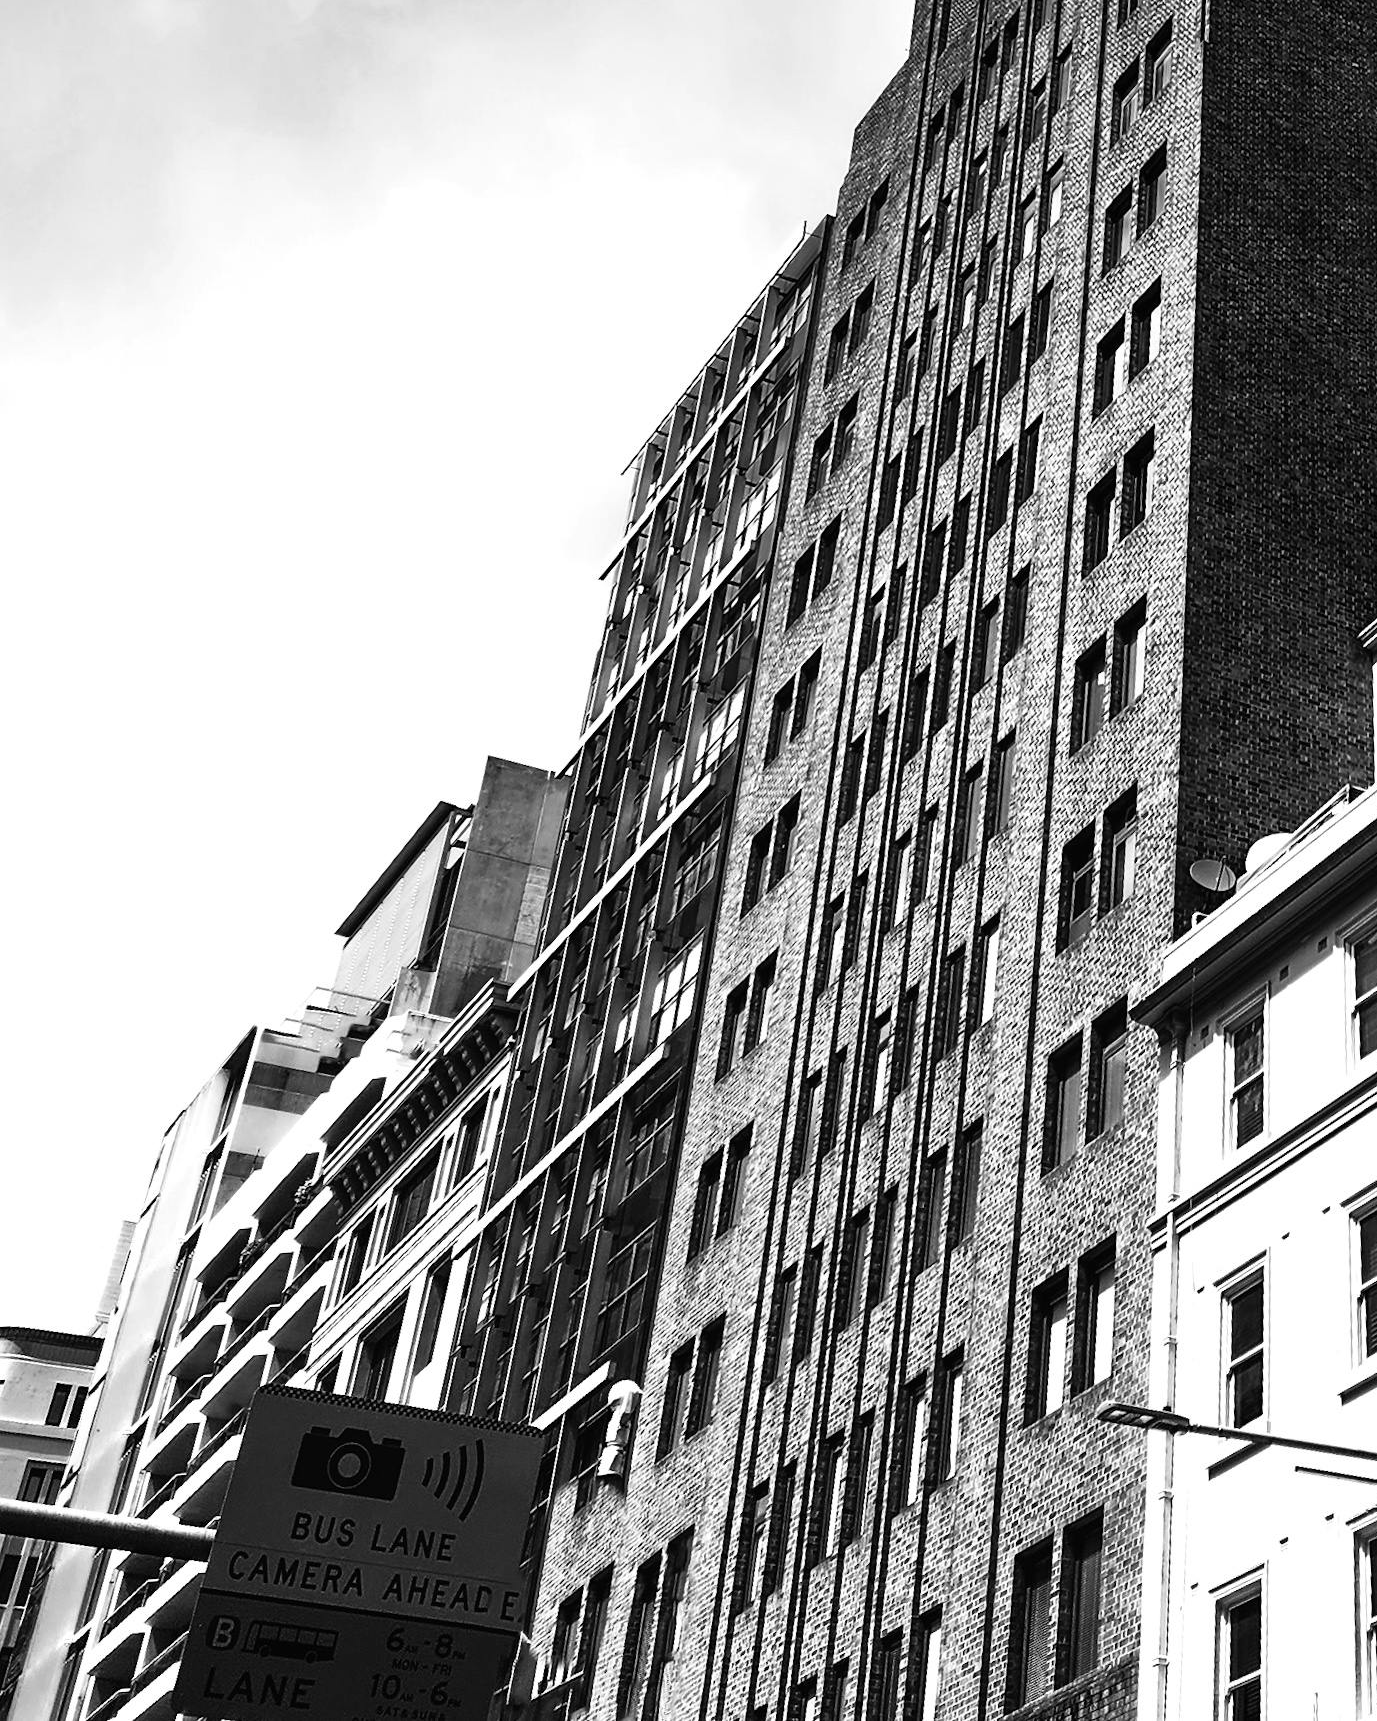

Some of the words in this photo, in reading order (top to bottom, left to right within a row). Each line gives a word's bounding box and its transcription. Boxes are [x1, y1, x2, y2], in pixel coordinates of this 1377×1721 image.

[291, 1512, 356, 1547] BUS
[370, 1524, 456, 1561] LANE
[229, 1550, 362, 1597] CAMERA
[382, 1573, 493, 1613] AHEAD
[500, 1591, 524, 1623] E
[211, 1616, 237, 1648] B
[203, 1666, 315, 1710] LANE
